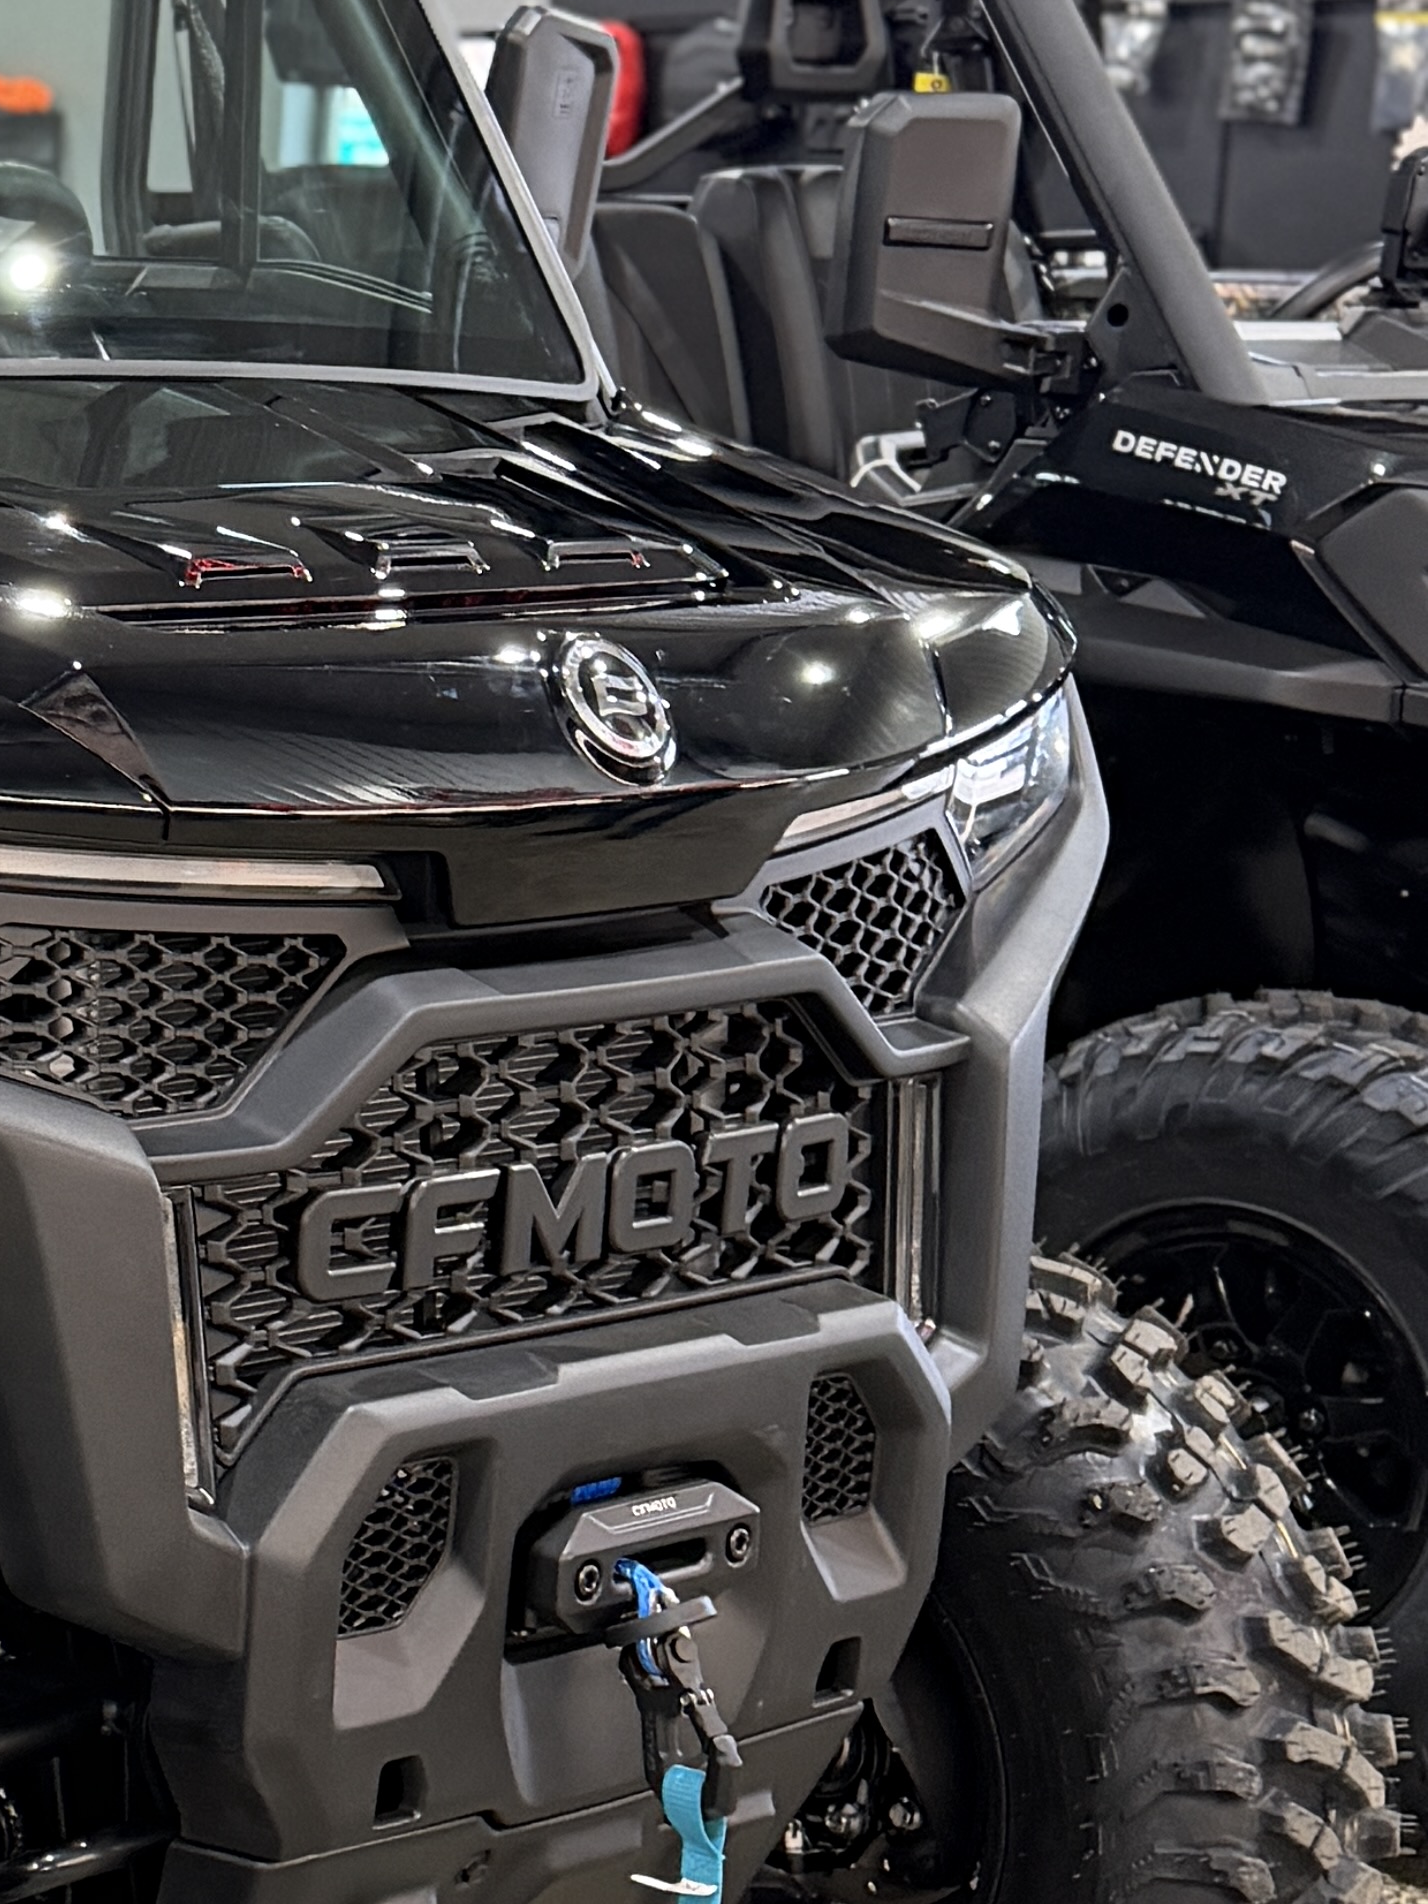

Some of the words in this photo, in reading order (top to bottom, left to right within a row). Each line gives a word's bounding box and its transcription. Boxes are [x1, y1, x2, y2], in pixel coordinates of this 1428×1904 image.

[1112, 429, 1287, 495] DEFENDER
[1215, 482, 1278, 506] XT
[298, 1111, 850, 1299] CFMOTO
[631, 1496, 677, 1517] CFMOTO
